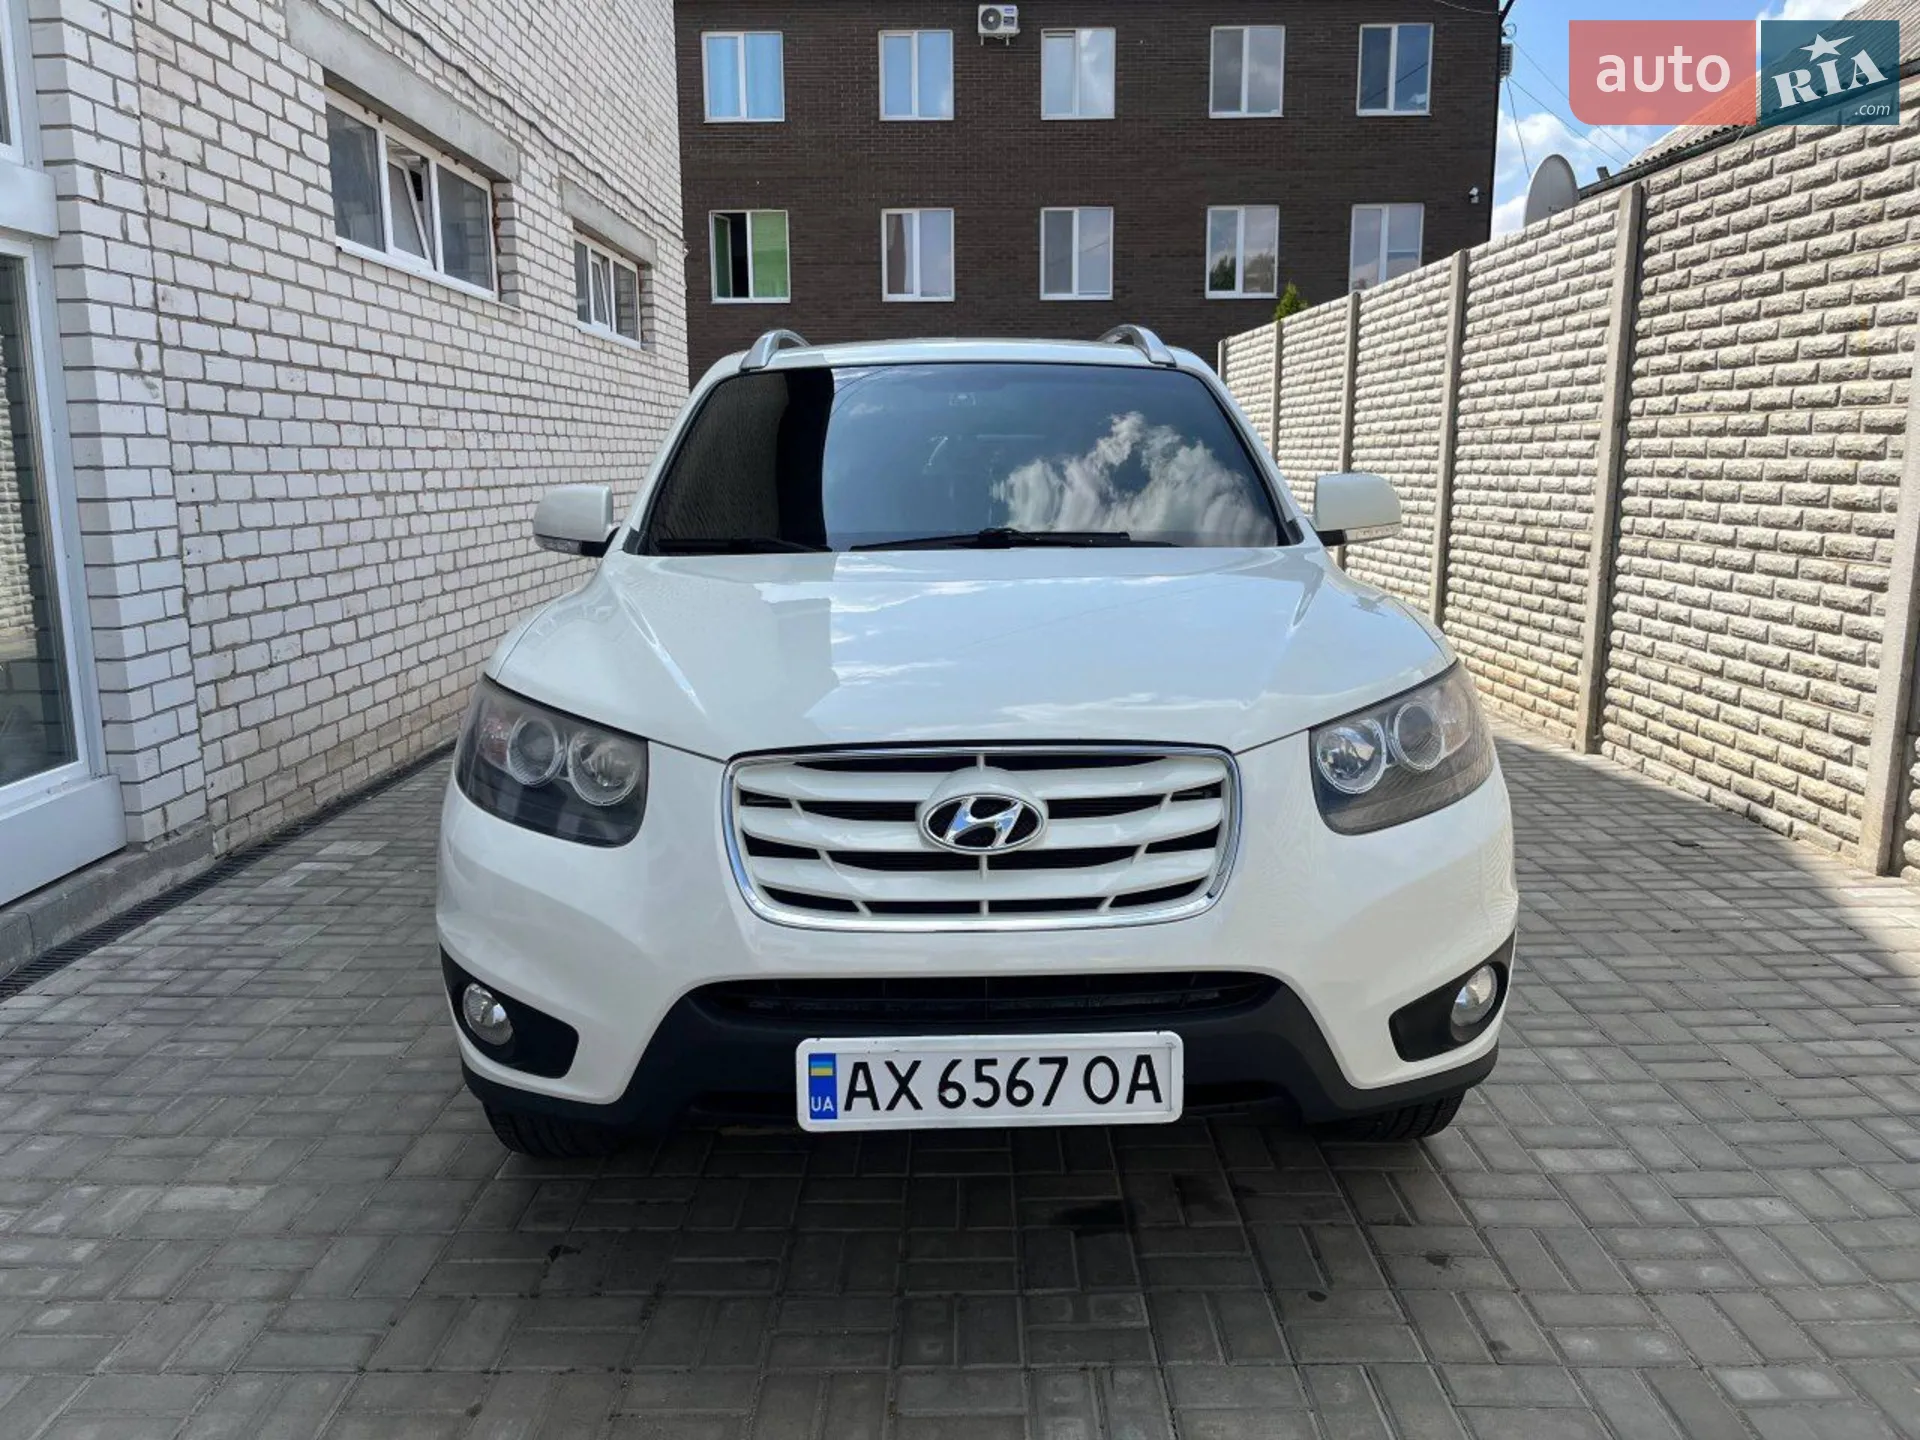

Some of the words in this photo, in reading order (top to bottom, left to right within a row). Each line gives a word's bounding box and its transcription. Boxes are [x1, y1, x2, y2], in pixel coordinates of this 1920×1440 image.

[843, 1060, 923, 1111] AX
[937, 1056, 1069, 1109] 6567
[1082, 1054, 1163, 1105] OA
[810, 1096, 834, 1112] UA
